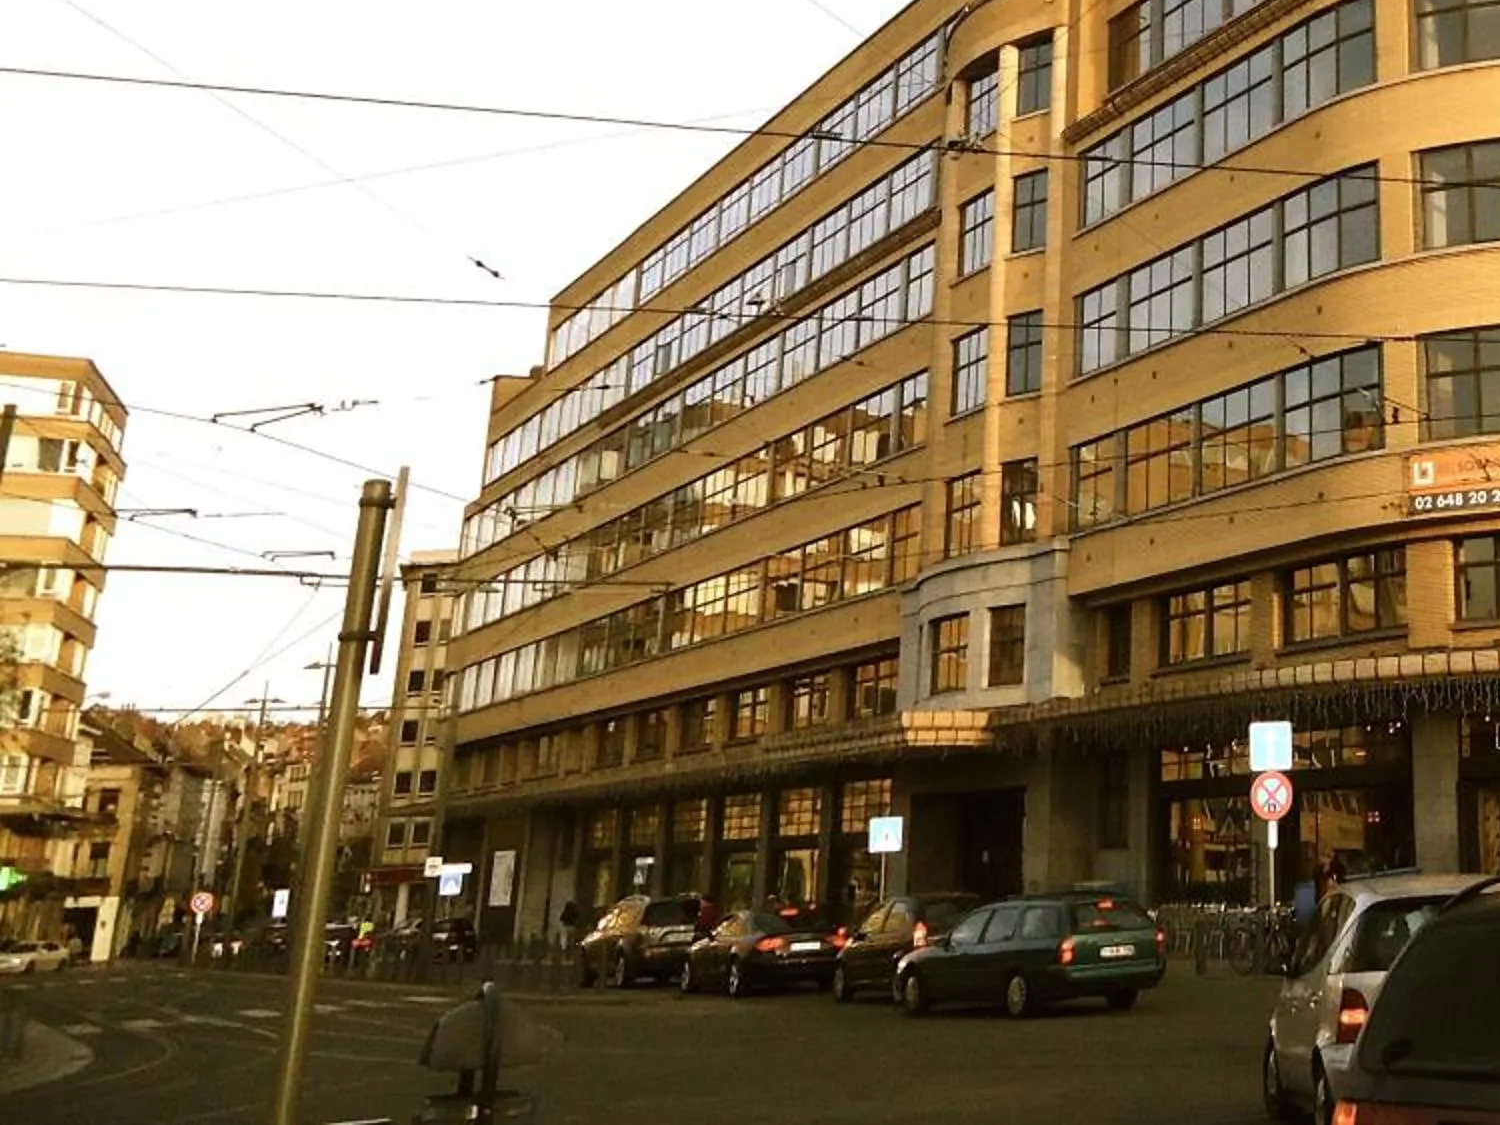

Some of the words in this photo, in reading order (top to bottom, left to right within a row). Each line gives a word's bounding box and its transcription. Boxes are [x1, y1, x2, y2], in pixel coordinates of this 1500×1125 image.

[1415, 496, 1433, 510] 02
[1436, 492, 1464, 508] 648
[1469, 490, 1487, 505] 20
